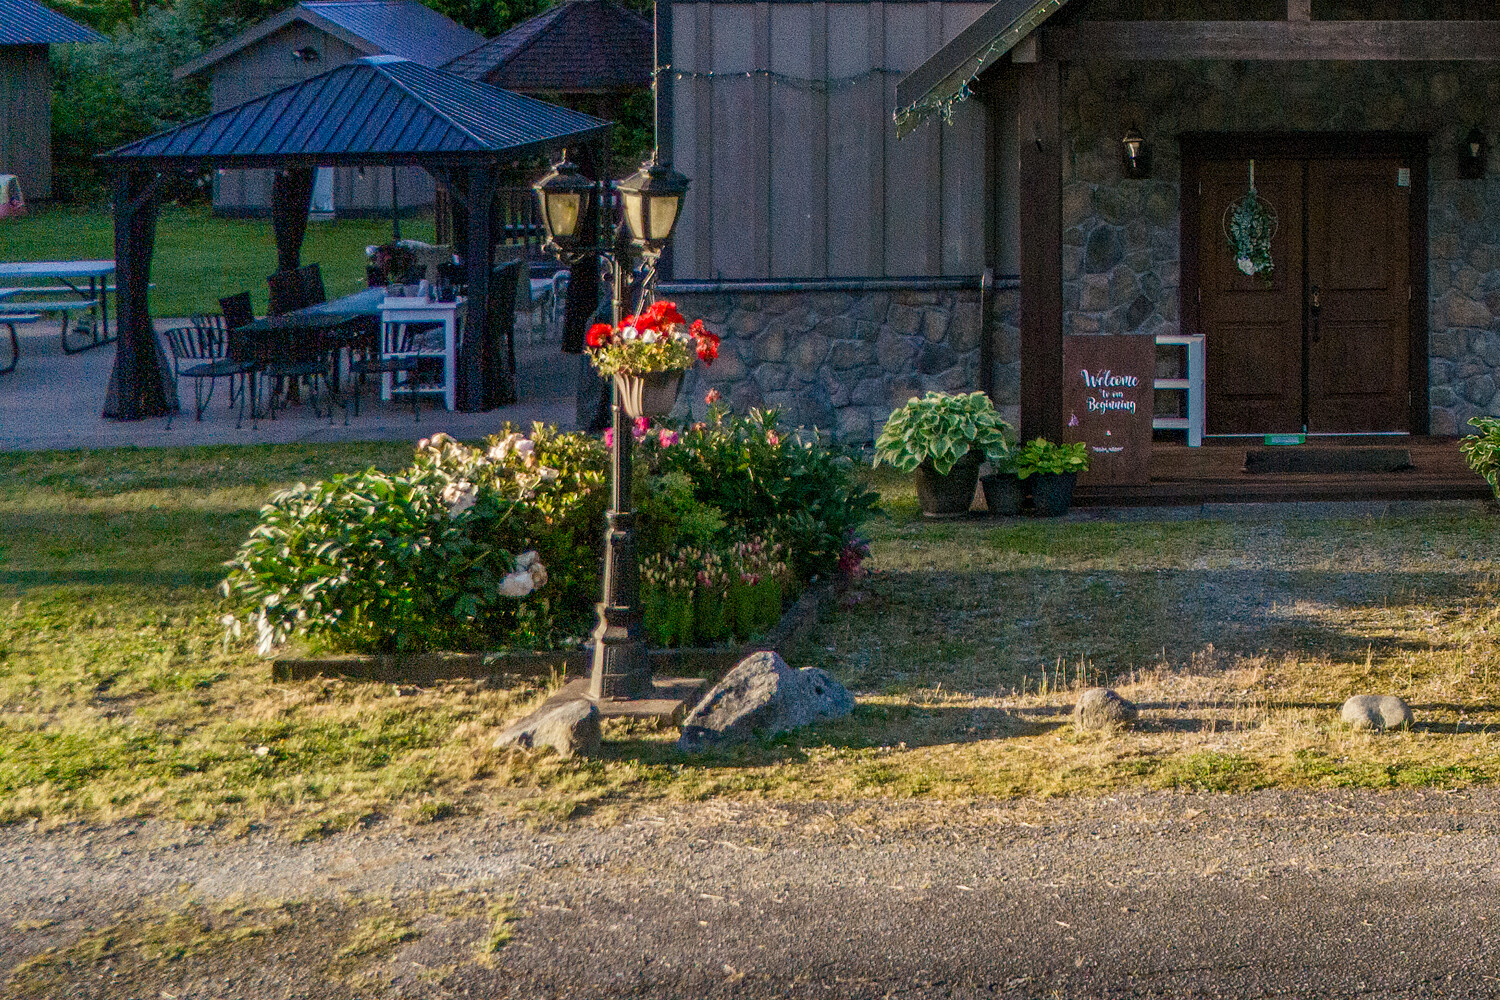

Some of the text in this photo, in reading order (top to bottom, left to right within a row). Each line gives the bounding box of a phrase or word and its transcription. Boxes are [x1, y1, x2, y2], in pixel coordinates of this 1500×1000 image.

[1081, 369, 1139, 387] Welcome
[1100, 389, 1109, 398] to
[1087, 397, 1136, 414] Beginning
